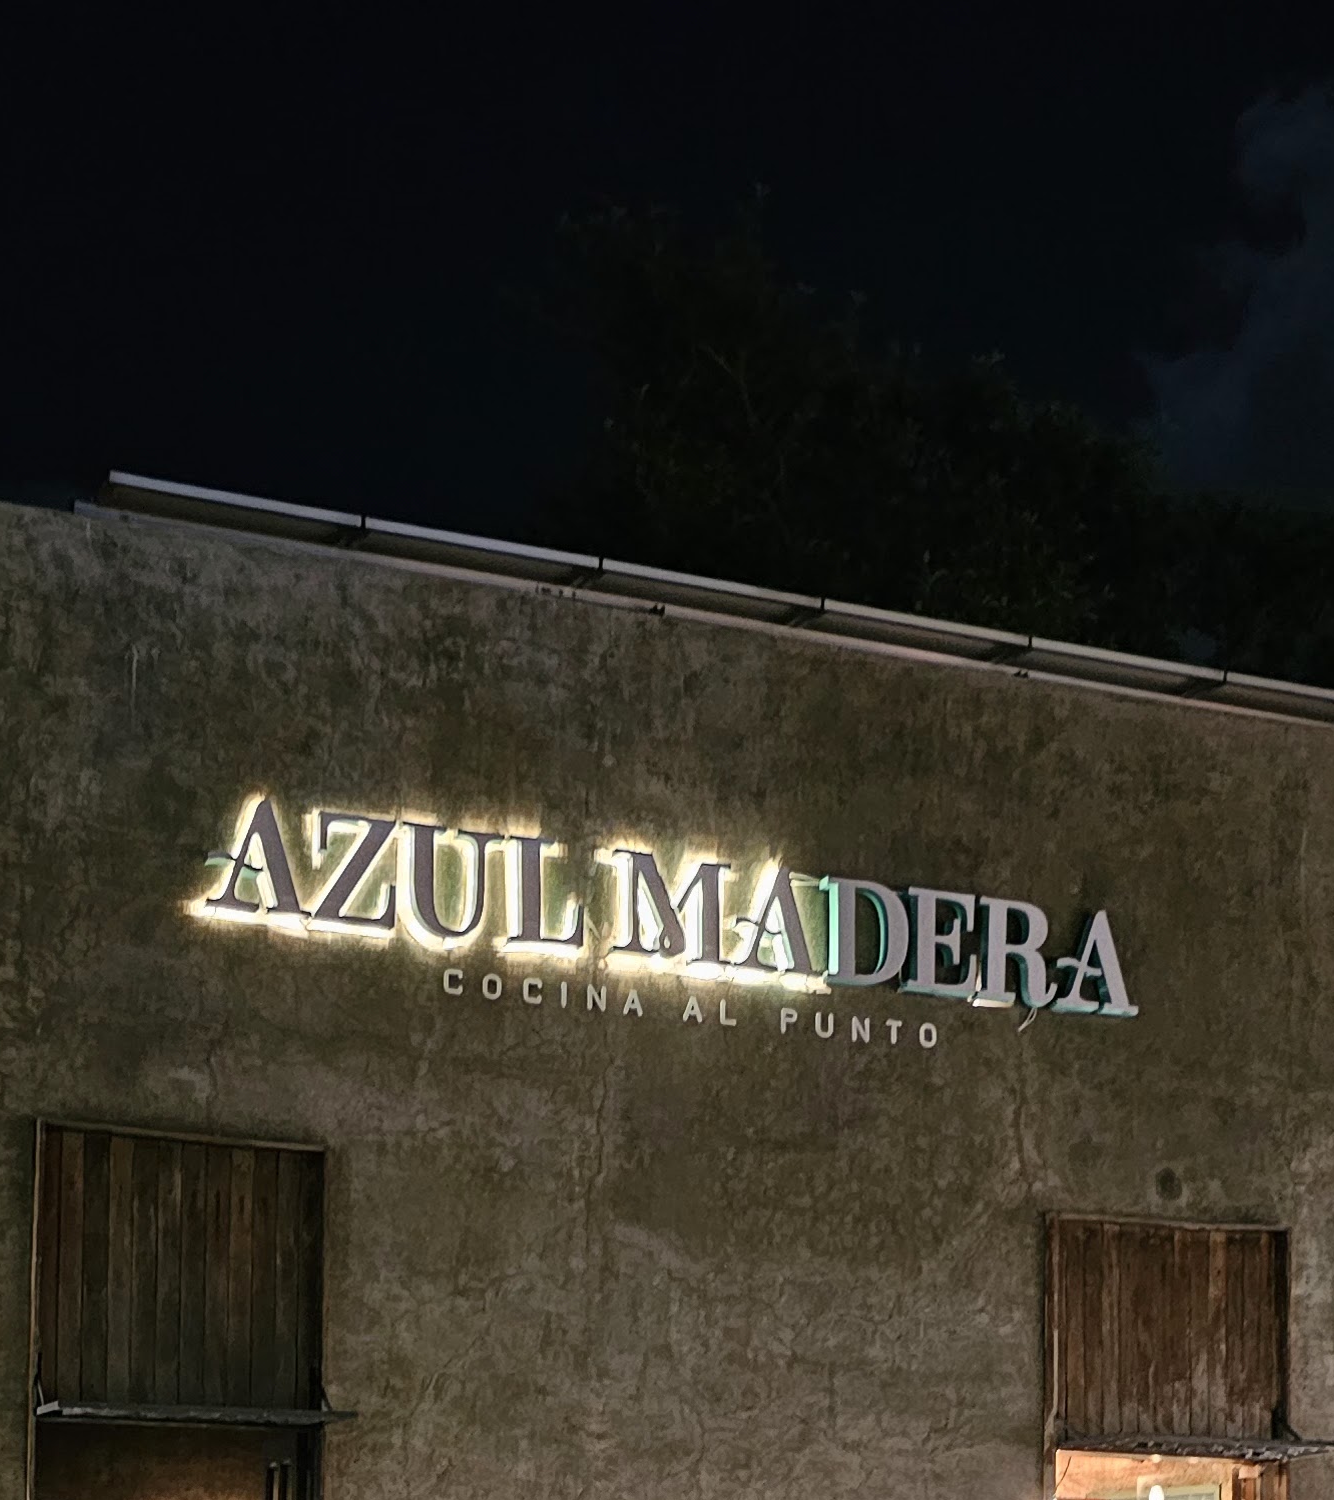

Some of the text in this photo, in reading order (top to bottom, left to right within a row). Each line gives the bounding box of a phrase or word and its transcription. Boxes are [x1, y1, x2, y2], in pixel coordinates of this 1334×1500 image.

[202, 797, 1139, 1016] AZUL MADERA
[443, 968, 938, 1048] COCINA AL PUNTO
